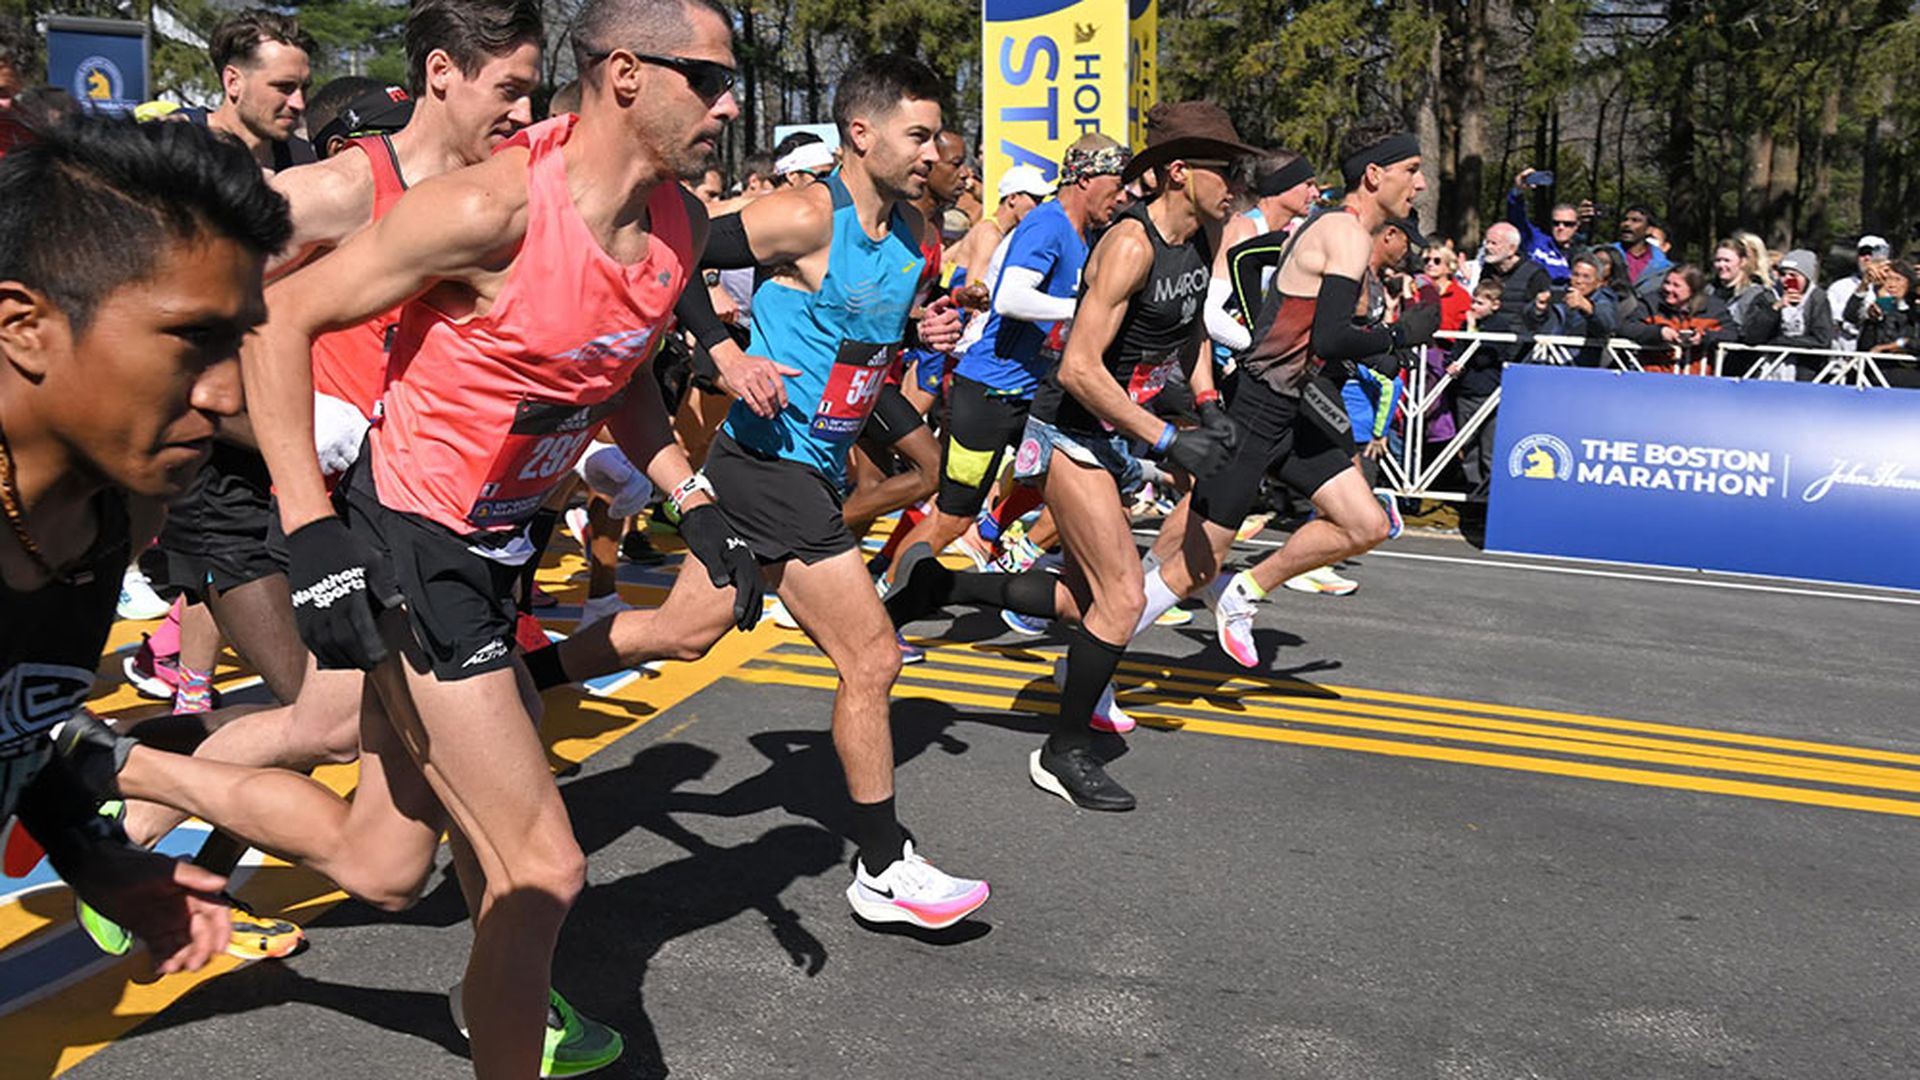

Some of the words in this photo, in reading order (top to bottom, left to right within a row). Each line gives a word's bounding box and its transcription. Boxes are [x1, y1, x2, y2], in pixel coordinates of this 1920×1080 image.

[1581, 438, 1638, 463] THE
[1644, 443, 1771, 473] BOSTON
[1577, 462, 1771, 498] MARATHON
[1801, 457, 1869, 503] John
